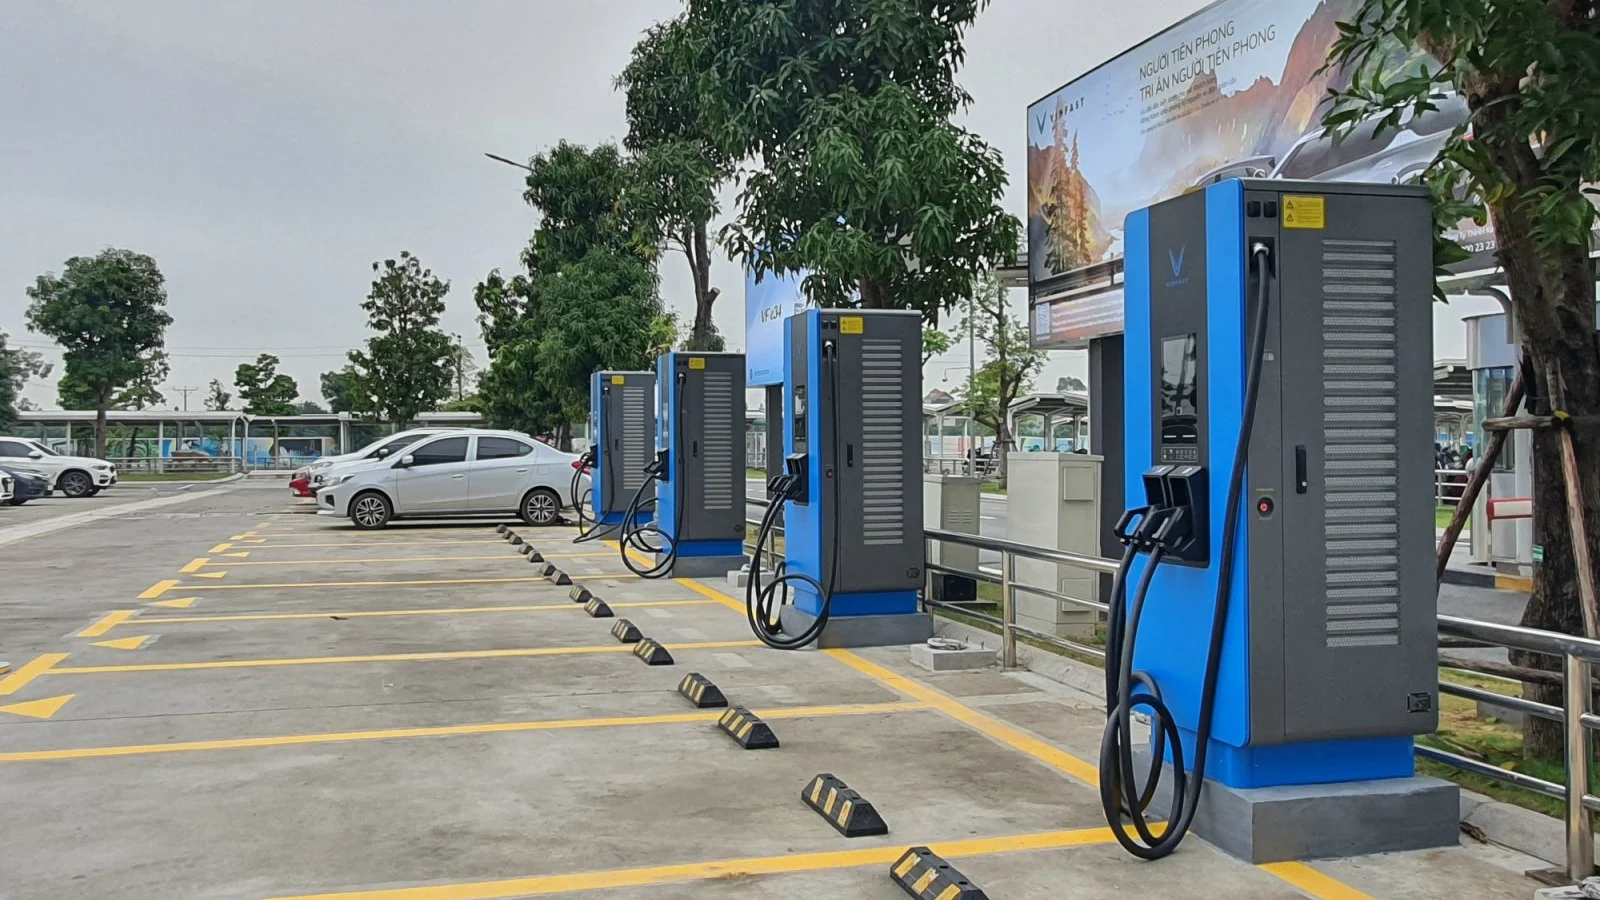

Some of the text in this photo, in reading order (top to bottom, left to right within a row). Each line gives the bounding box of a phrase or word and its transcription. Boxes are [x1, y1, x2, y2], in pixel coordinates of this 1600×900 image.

[1139, 52, 1170, 80] NGƯỜI
[1195, 20, 1235, 52] PHONG
[1139, 82, 1154, 101] TRI
[1172, 58, 1204, 86] NGƯỜI
[1232, 24, 1276, 58] PHONG
[1475, 243, 1484, 252] 23
[1485, 240, 1495, 250] 23
